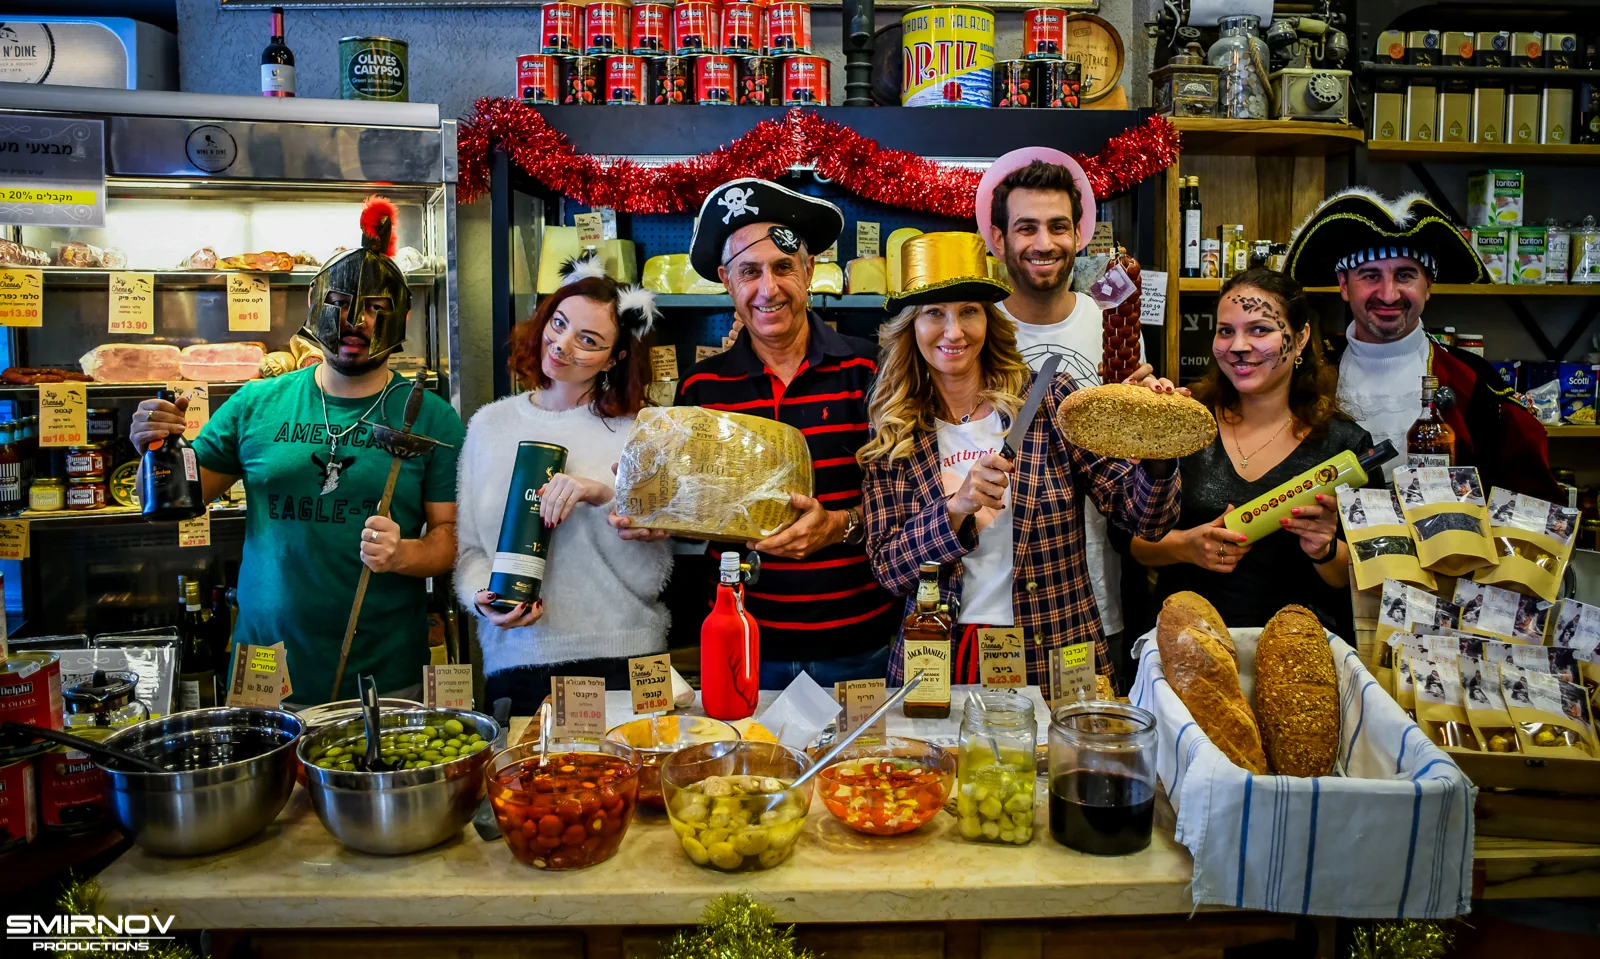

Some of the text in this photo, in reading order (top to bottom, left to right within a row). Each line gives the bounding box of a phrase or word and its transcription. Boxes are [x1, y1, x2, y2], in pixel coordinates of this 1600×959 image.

[14, 46, 36, 57] DINE
[358, 54, 396, 66] OLIVES
[354, 65, 400, 77] CALYPSO
[902, 40, 978, 96] ORTIZ
[26, 142, 73, 155] מבצעי
[1496, 180, 1520, 188] tariton
[10, 190, 32, 200] 20%
[36, 194, 72, 202] מקבלים
[239, 312, 258, 320] ₪16
[112, 320, 148, 330] ₪13.90
[1568, 376, 1590, 385] Scotti
[274, 422, 383, 449] AMERICA
[1424, 456, 1446, 466] Morgan
[660, 468, 668, 508] REGGIAN
[268, 494, 377, 524] EAGLE-7
[533, 542, 542, 552] 12
[908, 648, 922, 660] JACK
[984, 651, 1020, 660] ארטישוק
[252, 662, 276, 671] שחורים
[636, 676, 666, 686] עגבניות
[1, 683, 32, 696] Delphi
[256, 684, 274, 693] 8.00
[573, 692, 598, 700] פיקנטי
[642, 690, 662, 698] קונפי
[857, 694, 874, 702] חריף
[8, 698, 36, 708] OLIVES
[455, 698, 463, 706] 10
